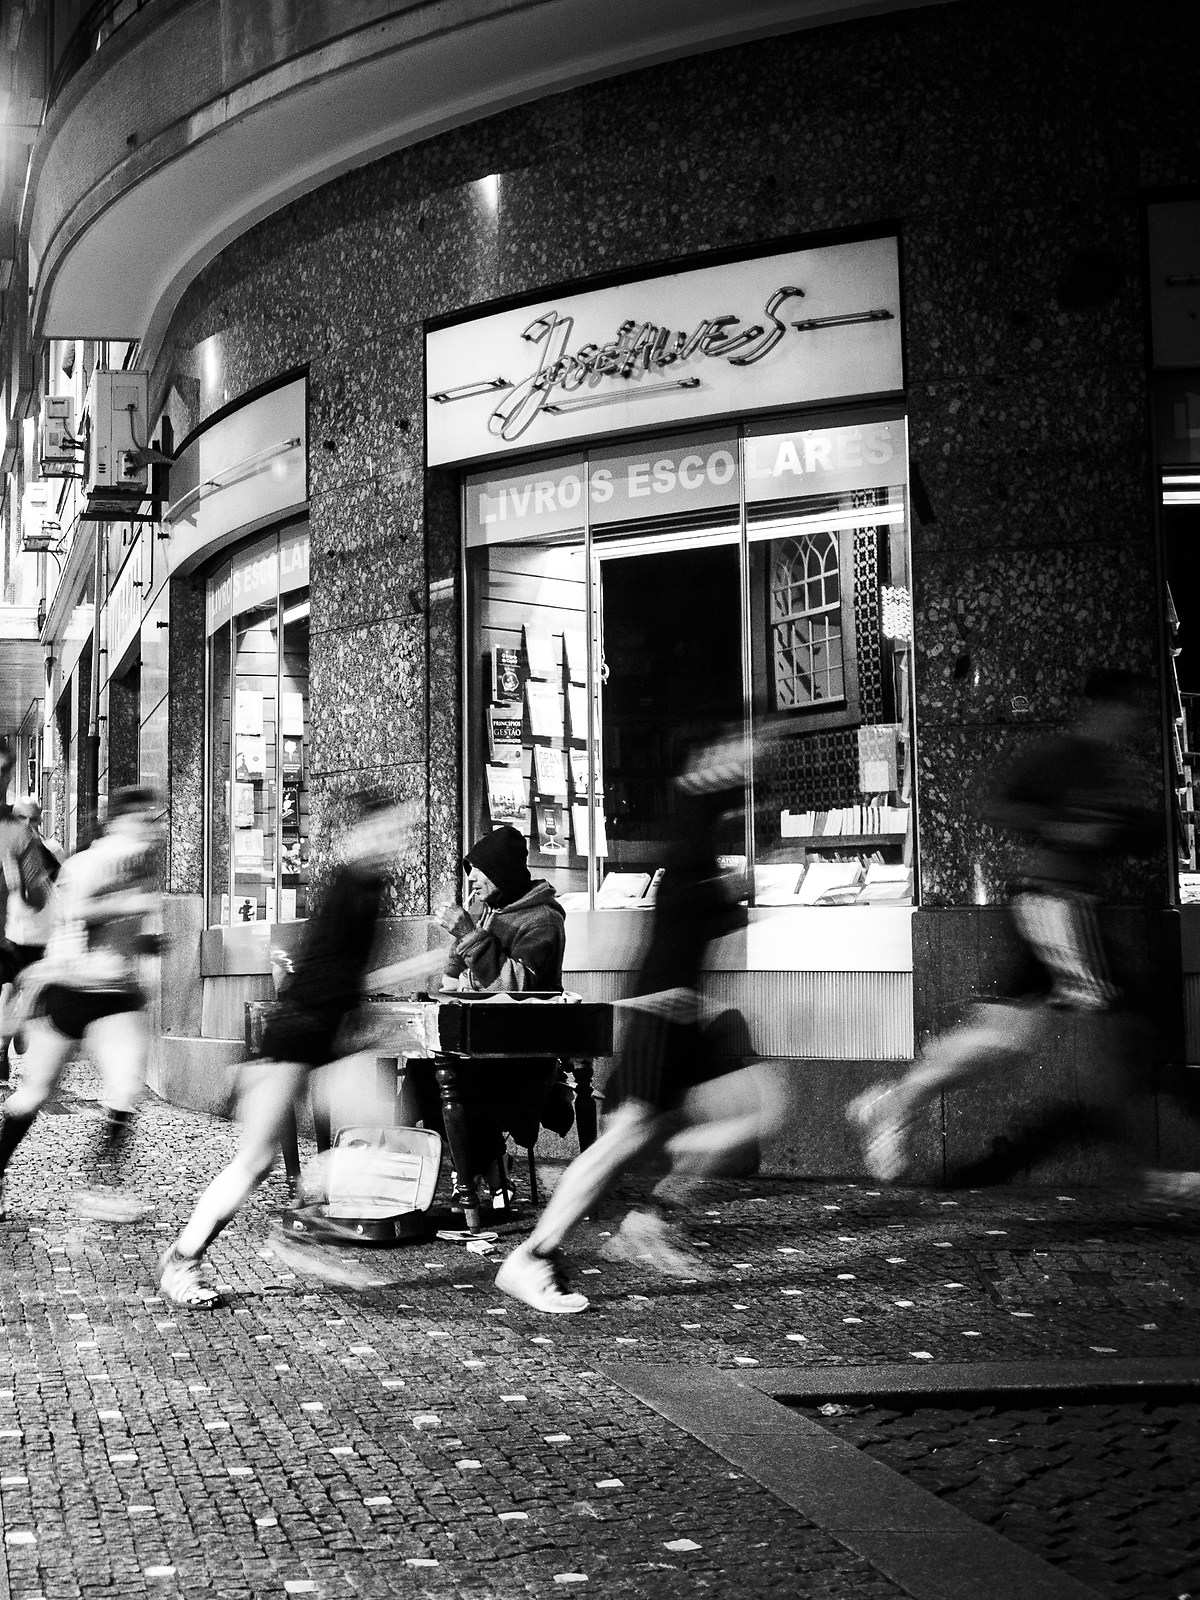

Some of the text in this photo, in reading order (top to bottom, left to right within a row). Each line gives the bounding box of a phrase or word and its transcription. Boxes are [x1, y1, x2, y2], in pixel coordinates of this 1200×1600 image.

[478, 428, 894, 525] LIVROS ESCOLARES
[493, 727, 521, 736] GESTÃO
[541, 765, 555, 778] DES
